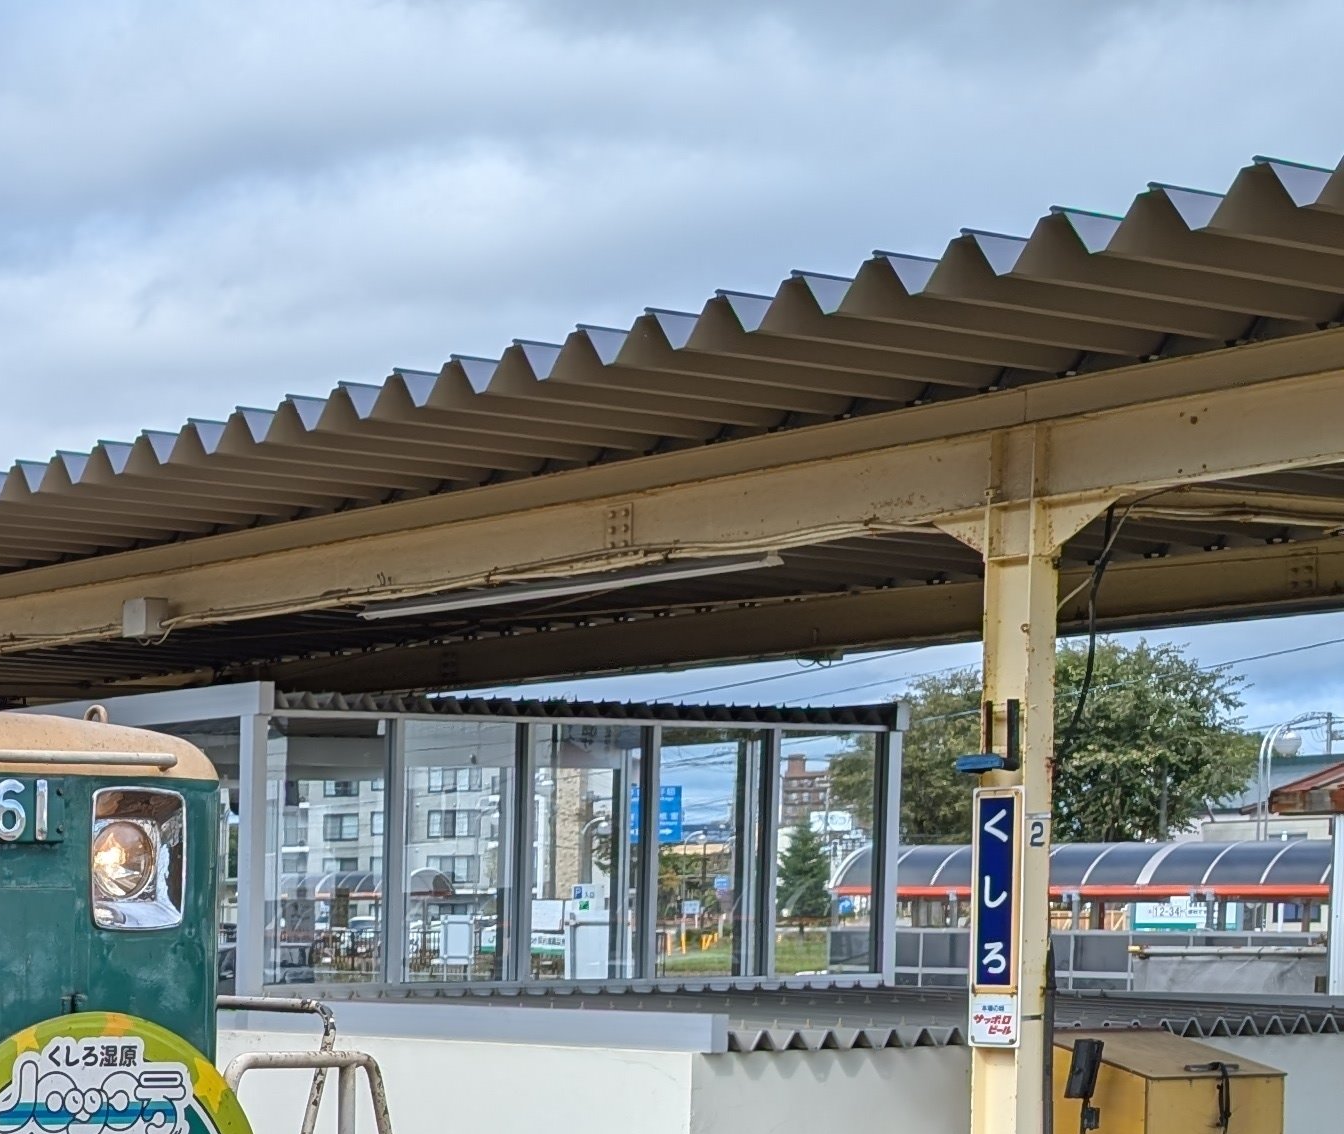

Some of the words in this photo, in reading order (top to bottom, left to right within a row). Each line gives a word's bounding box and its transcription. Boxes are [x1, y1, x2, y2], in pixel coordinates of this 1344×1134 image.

[1030, 821, 1045, 847] 2
[982, 808, 1009, 975] くしろ
[1154, 907, 1180, 917] 12-34
[973, 1013, 1013, 1025] サッポロ
[987, 1025, 1012, 1035] ビール
[47, 1044, 139, 1068] くしろ湿原
